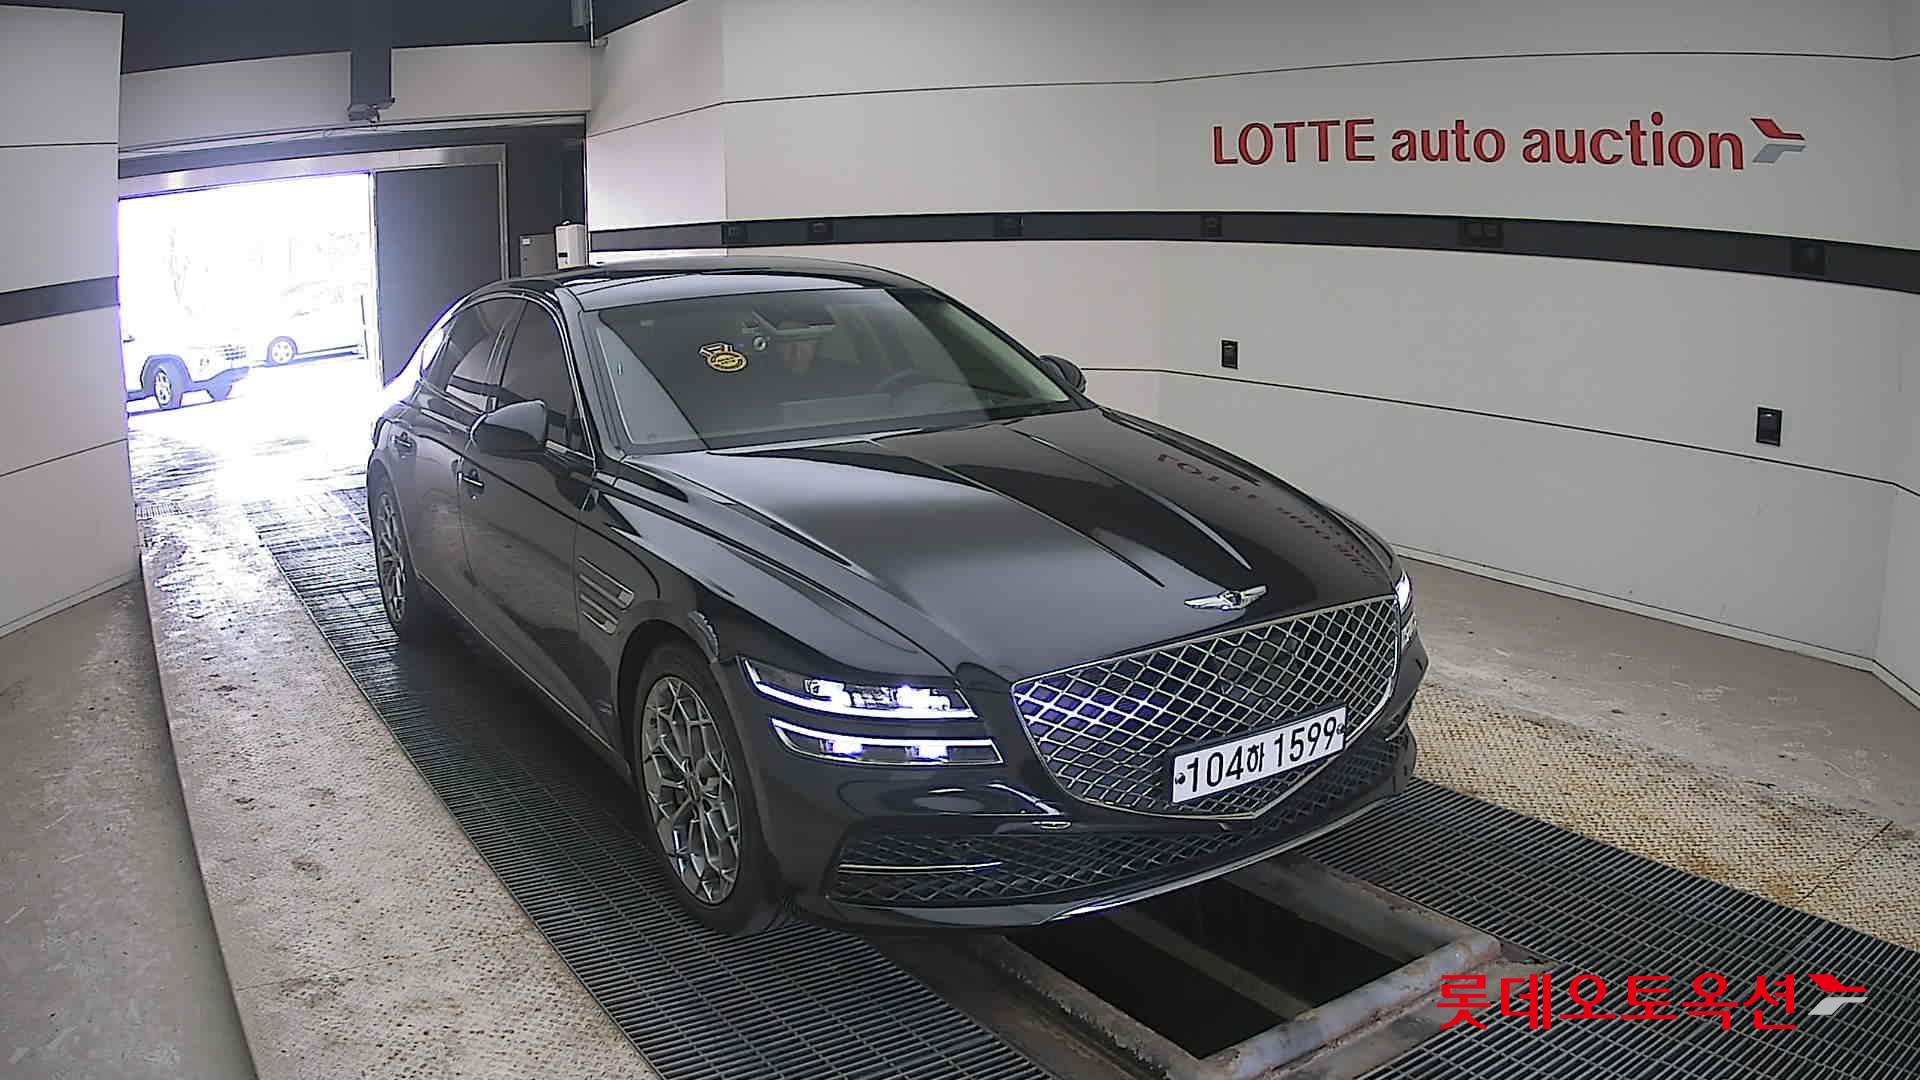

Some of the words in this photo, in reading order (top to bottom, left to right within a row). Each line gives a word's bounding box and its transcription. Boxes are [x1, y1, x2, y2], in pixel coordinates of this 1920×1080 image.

[1213, 118, 1377, 166] LOTTE
[1391, 119, 1507, 163] auto
[1522, 112, 1745, 171] auction
[1186, 742, 1265, 793] 104하
[1273, 716, 1338, 768] 1599
